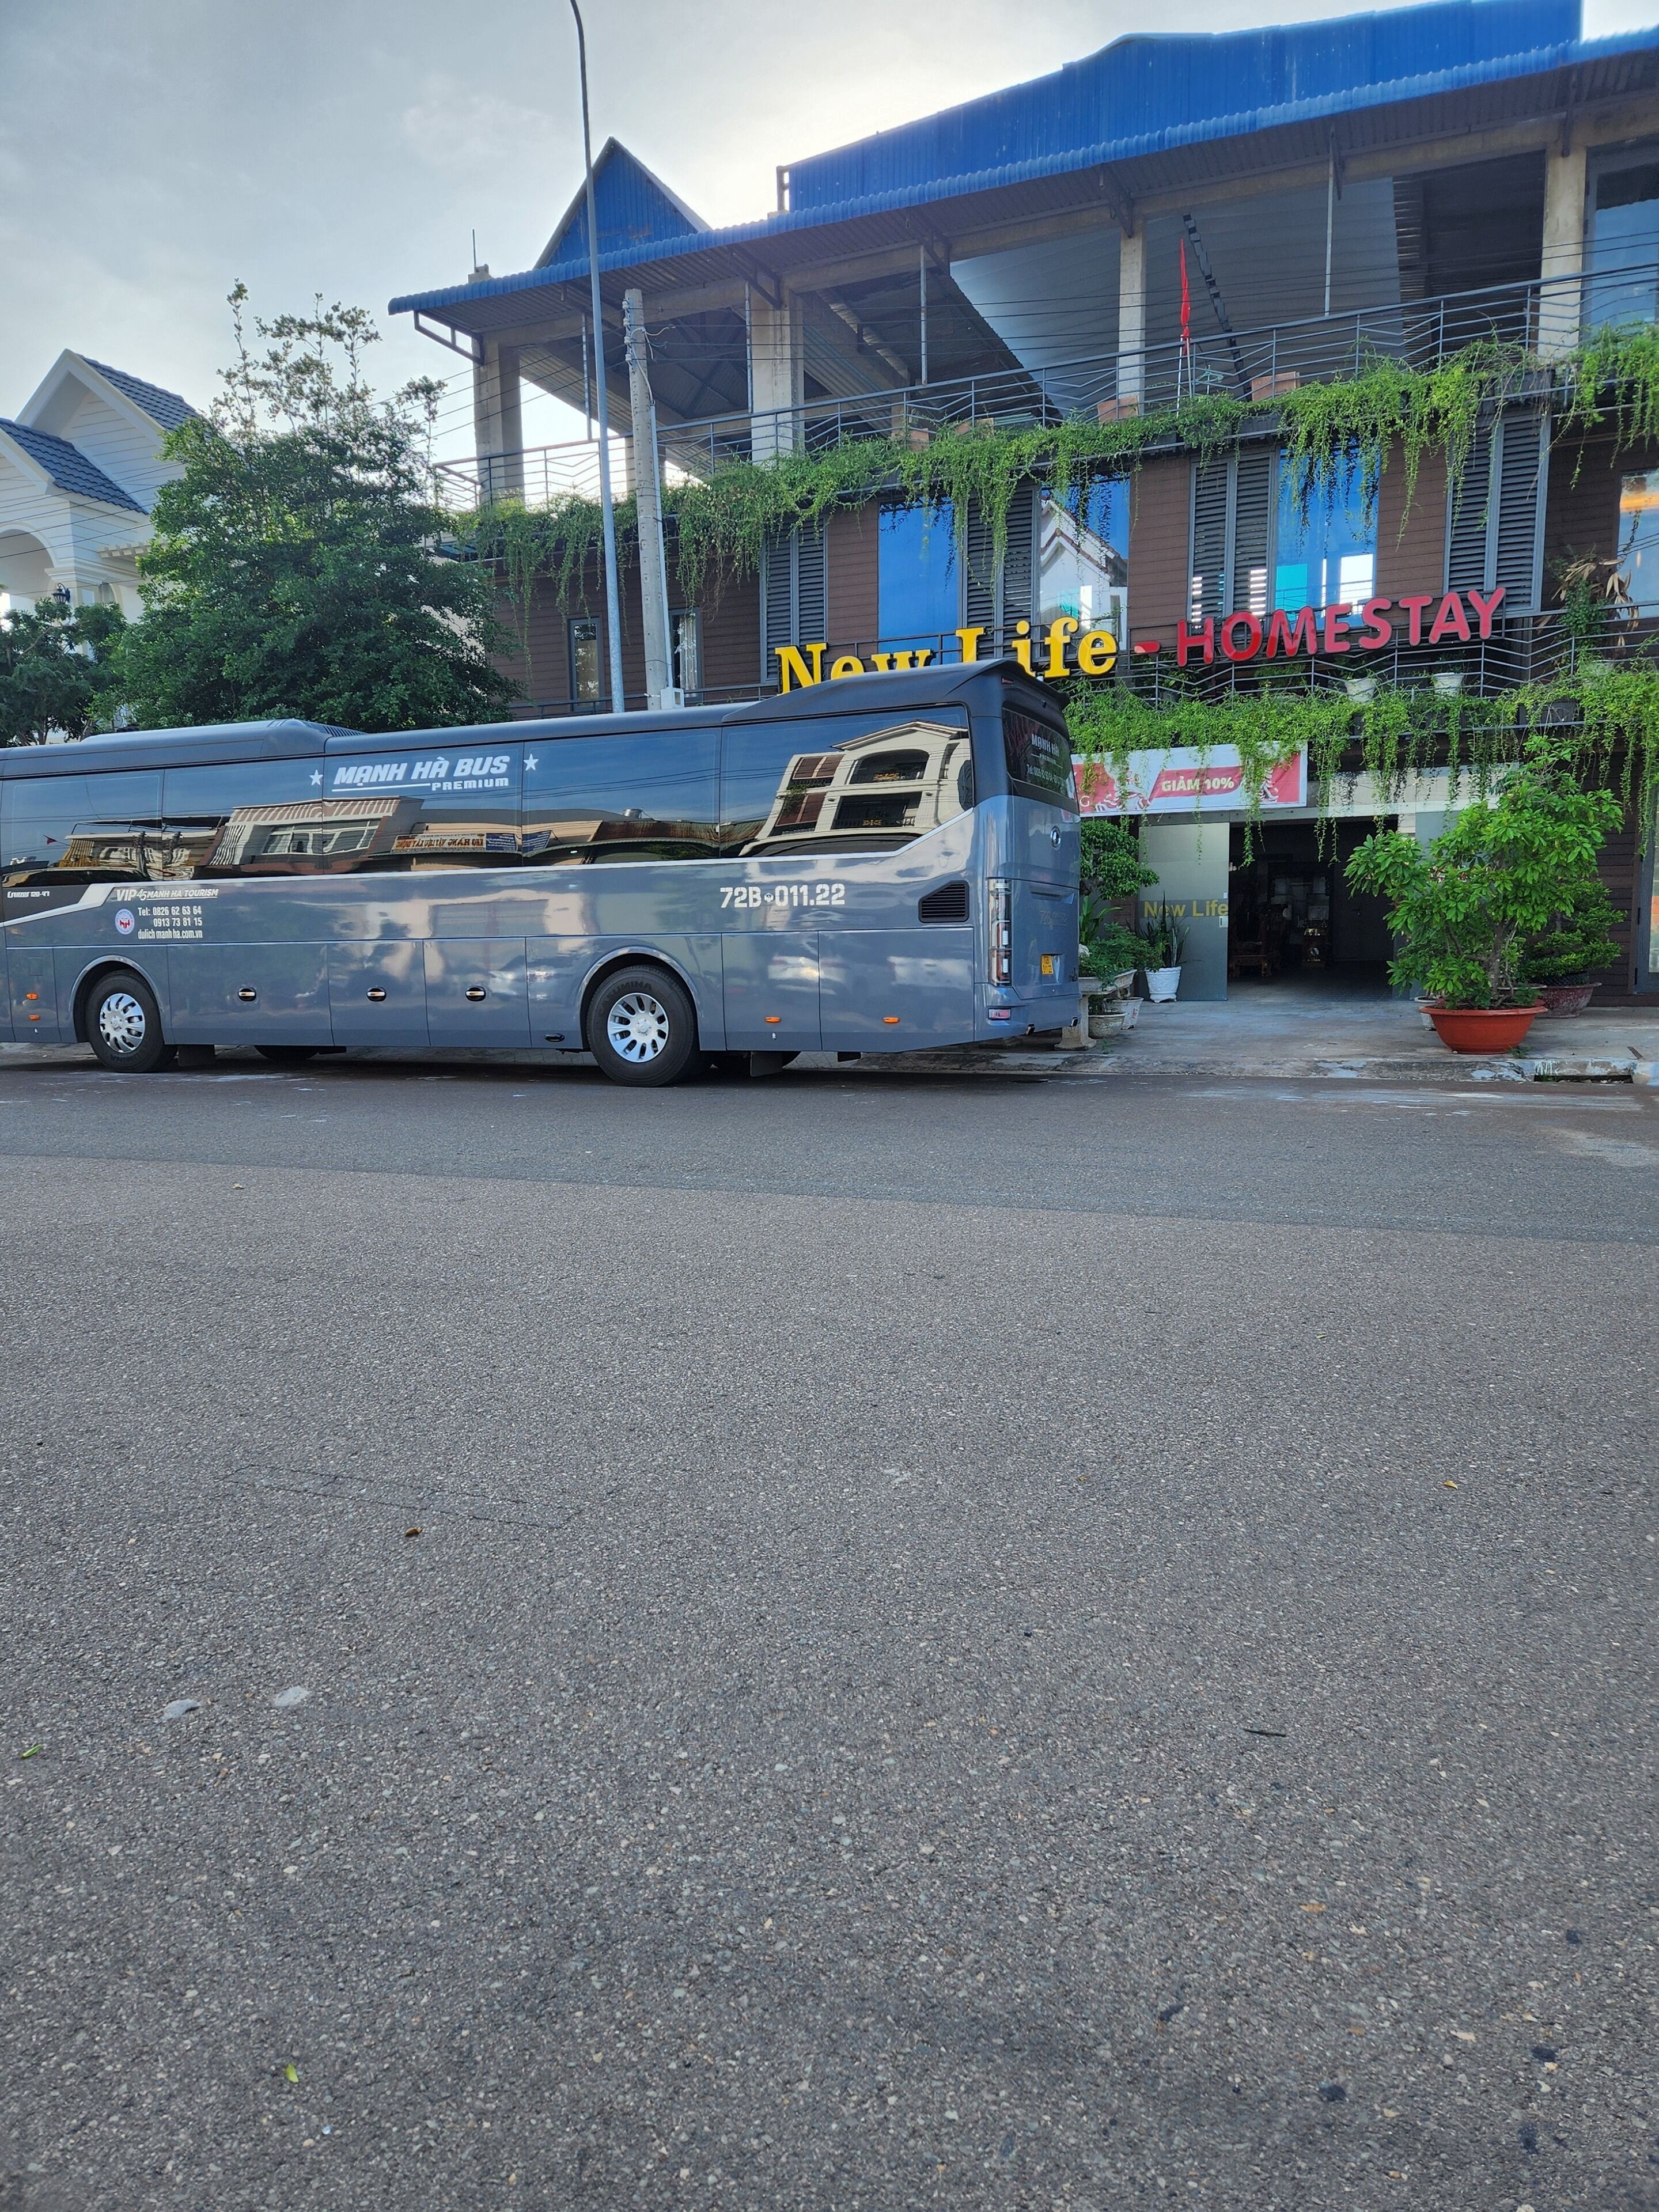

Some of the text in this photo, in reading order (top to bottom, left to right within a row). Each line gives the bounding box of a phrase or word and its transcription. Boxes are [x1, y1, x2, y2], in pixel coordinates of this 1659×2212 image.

[1176, 586, 1506, 667] HOMESTAY
[334, 756, 510, 786] MẠNH HÀ BUS
[431, 777, 509, 791] PREMIUM
[1161, 776, 1235, 792] GIẢM 10%
[184, 889, 219, 897] TOURISM
[720, 883, 845, 908] 72B 011.22
[138, 906, 202, 916] Tel: 0826 62 63 64
[1143, 899, 1229, 918] New Life
[153, 917, 202, 927] 0913 73 81 15
